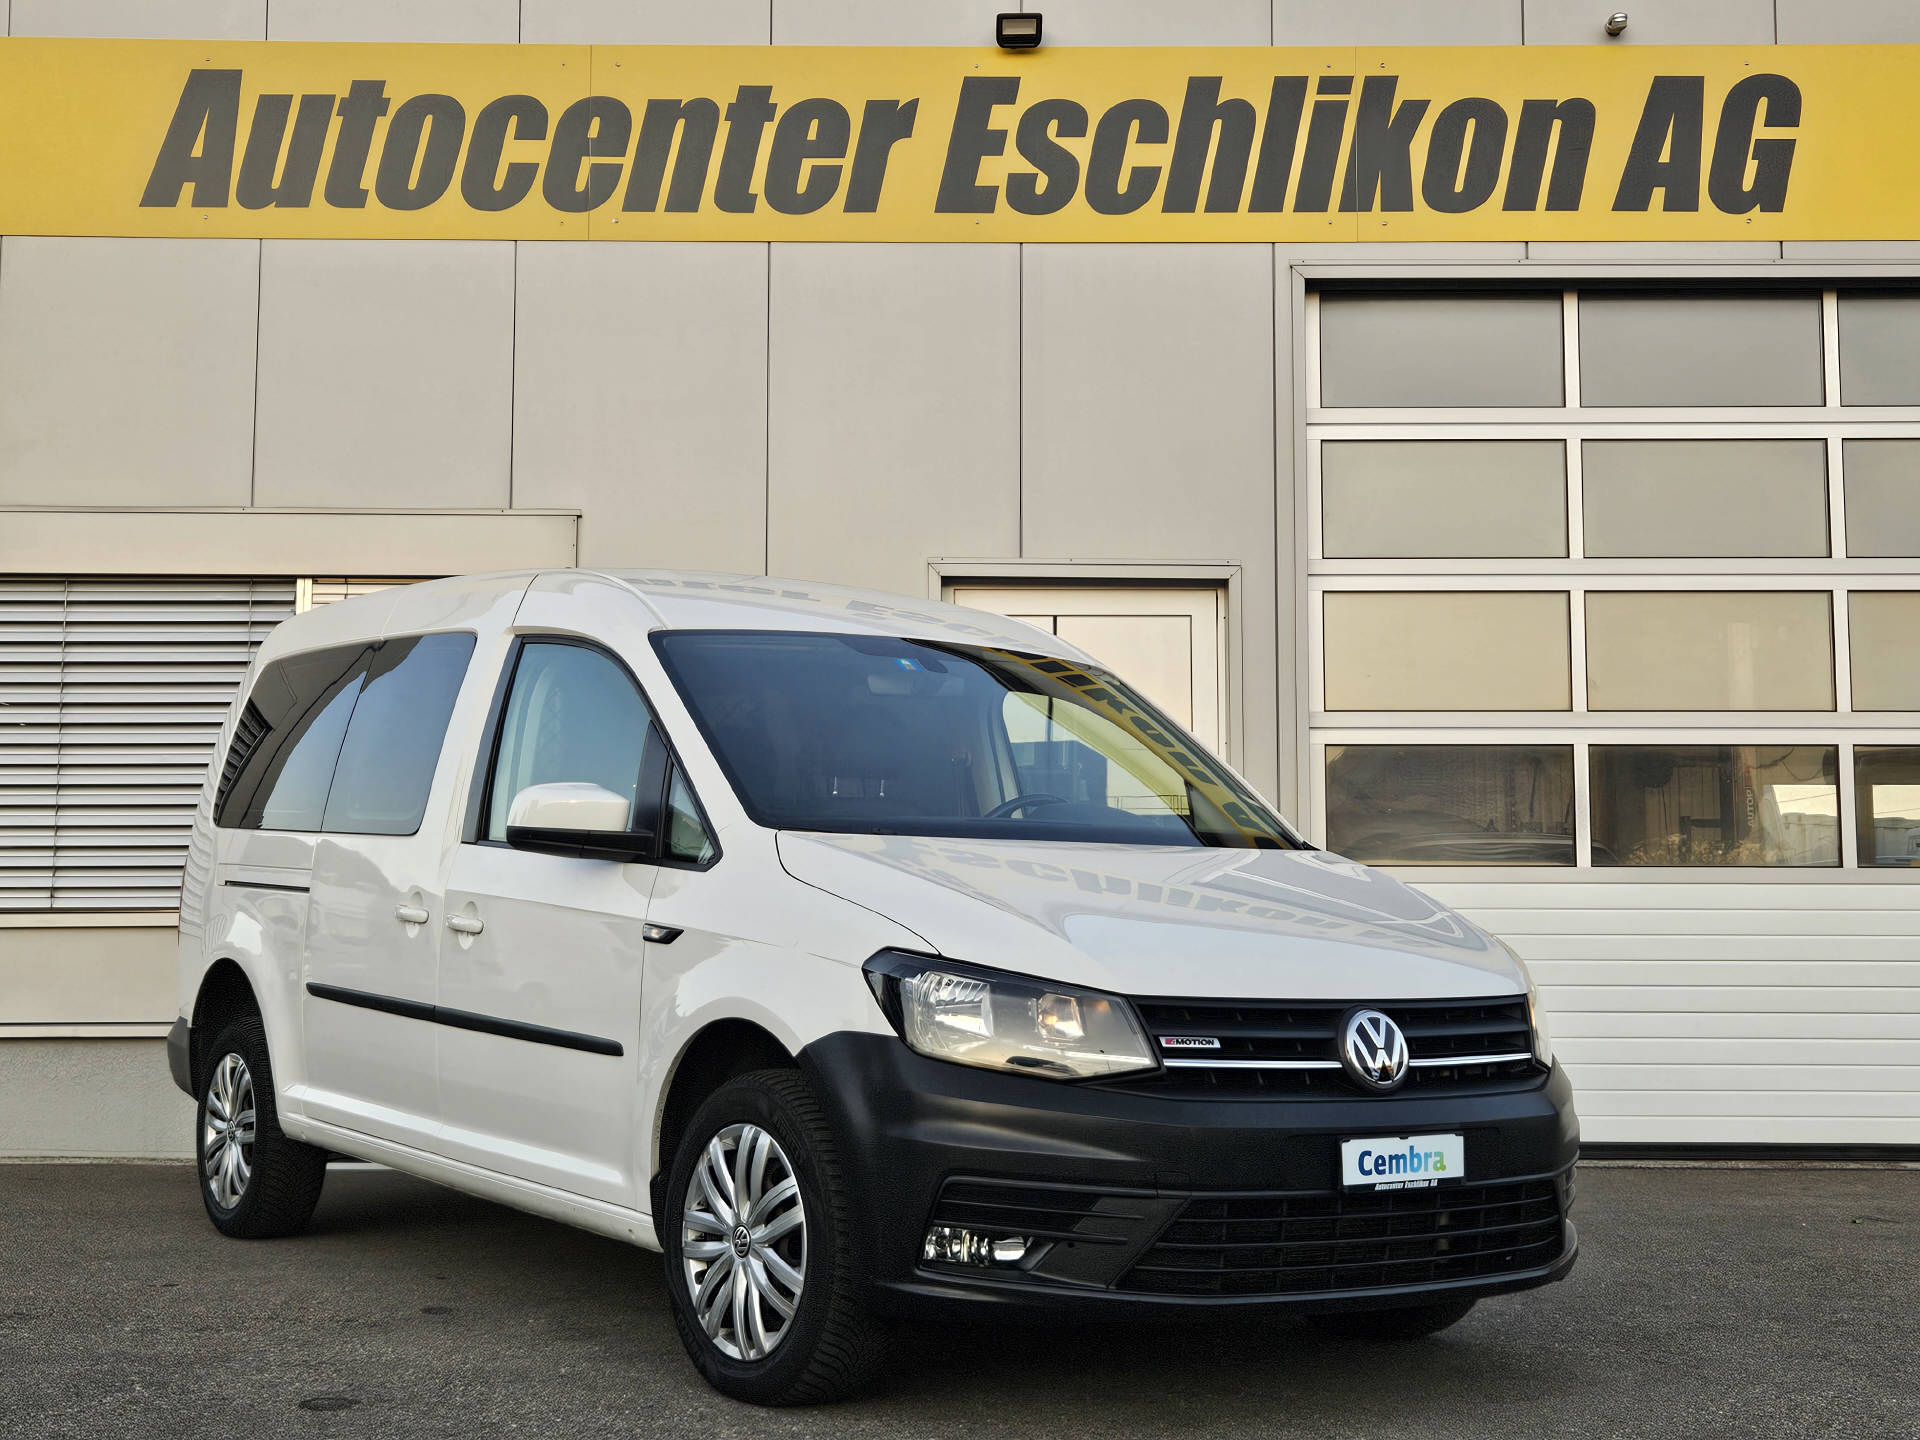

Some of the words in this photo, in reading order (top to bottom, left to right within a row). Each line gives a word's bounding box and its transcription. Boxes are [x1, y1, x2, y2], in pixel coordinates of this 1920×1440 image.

[138, 68, 920, 216] Autocenter
[934, 75, 1596, 216] Eschlikon
[1611, 73, 1803, 216] AG
[1357, 1144, 1447, 1177] Cembra
